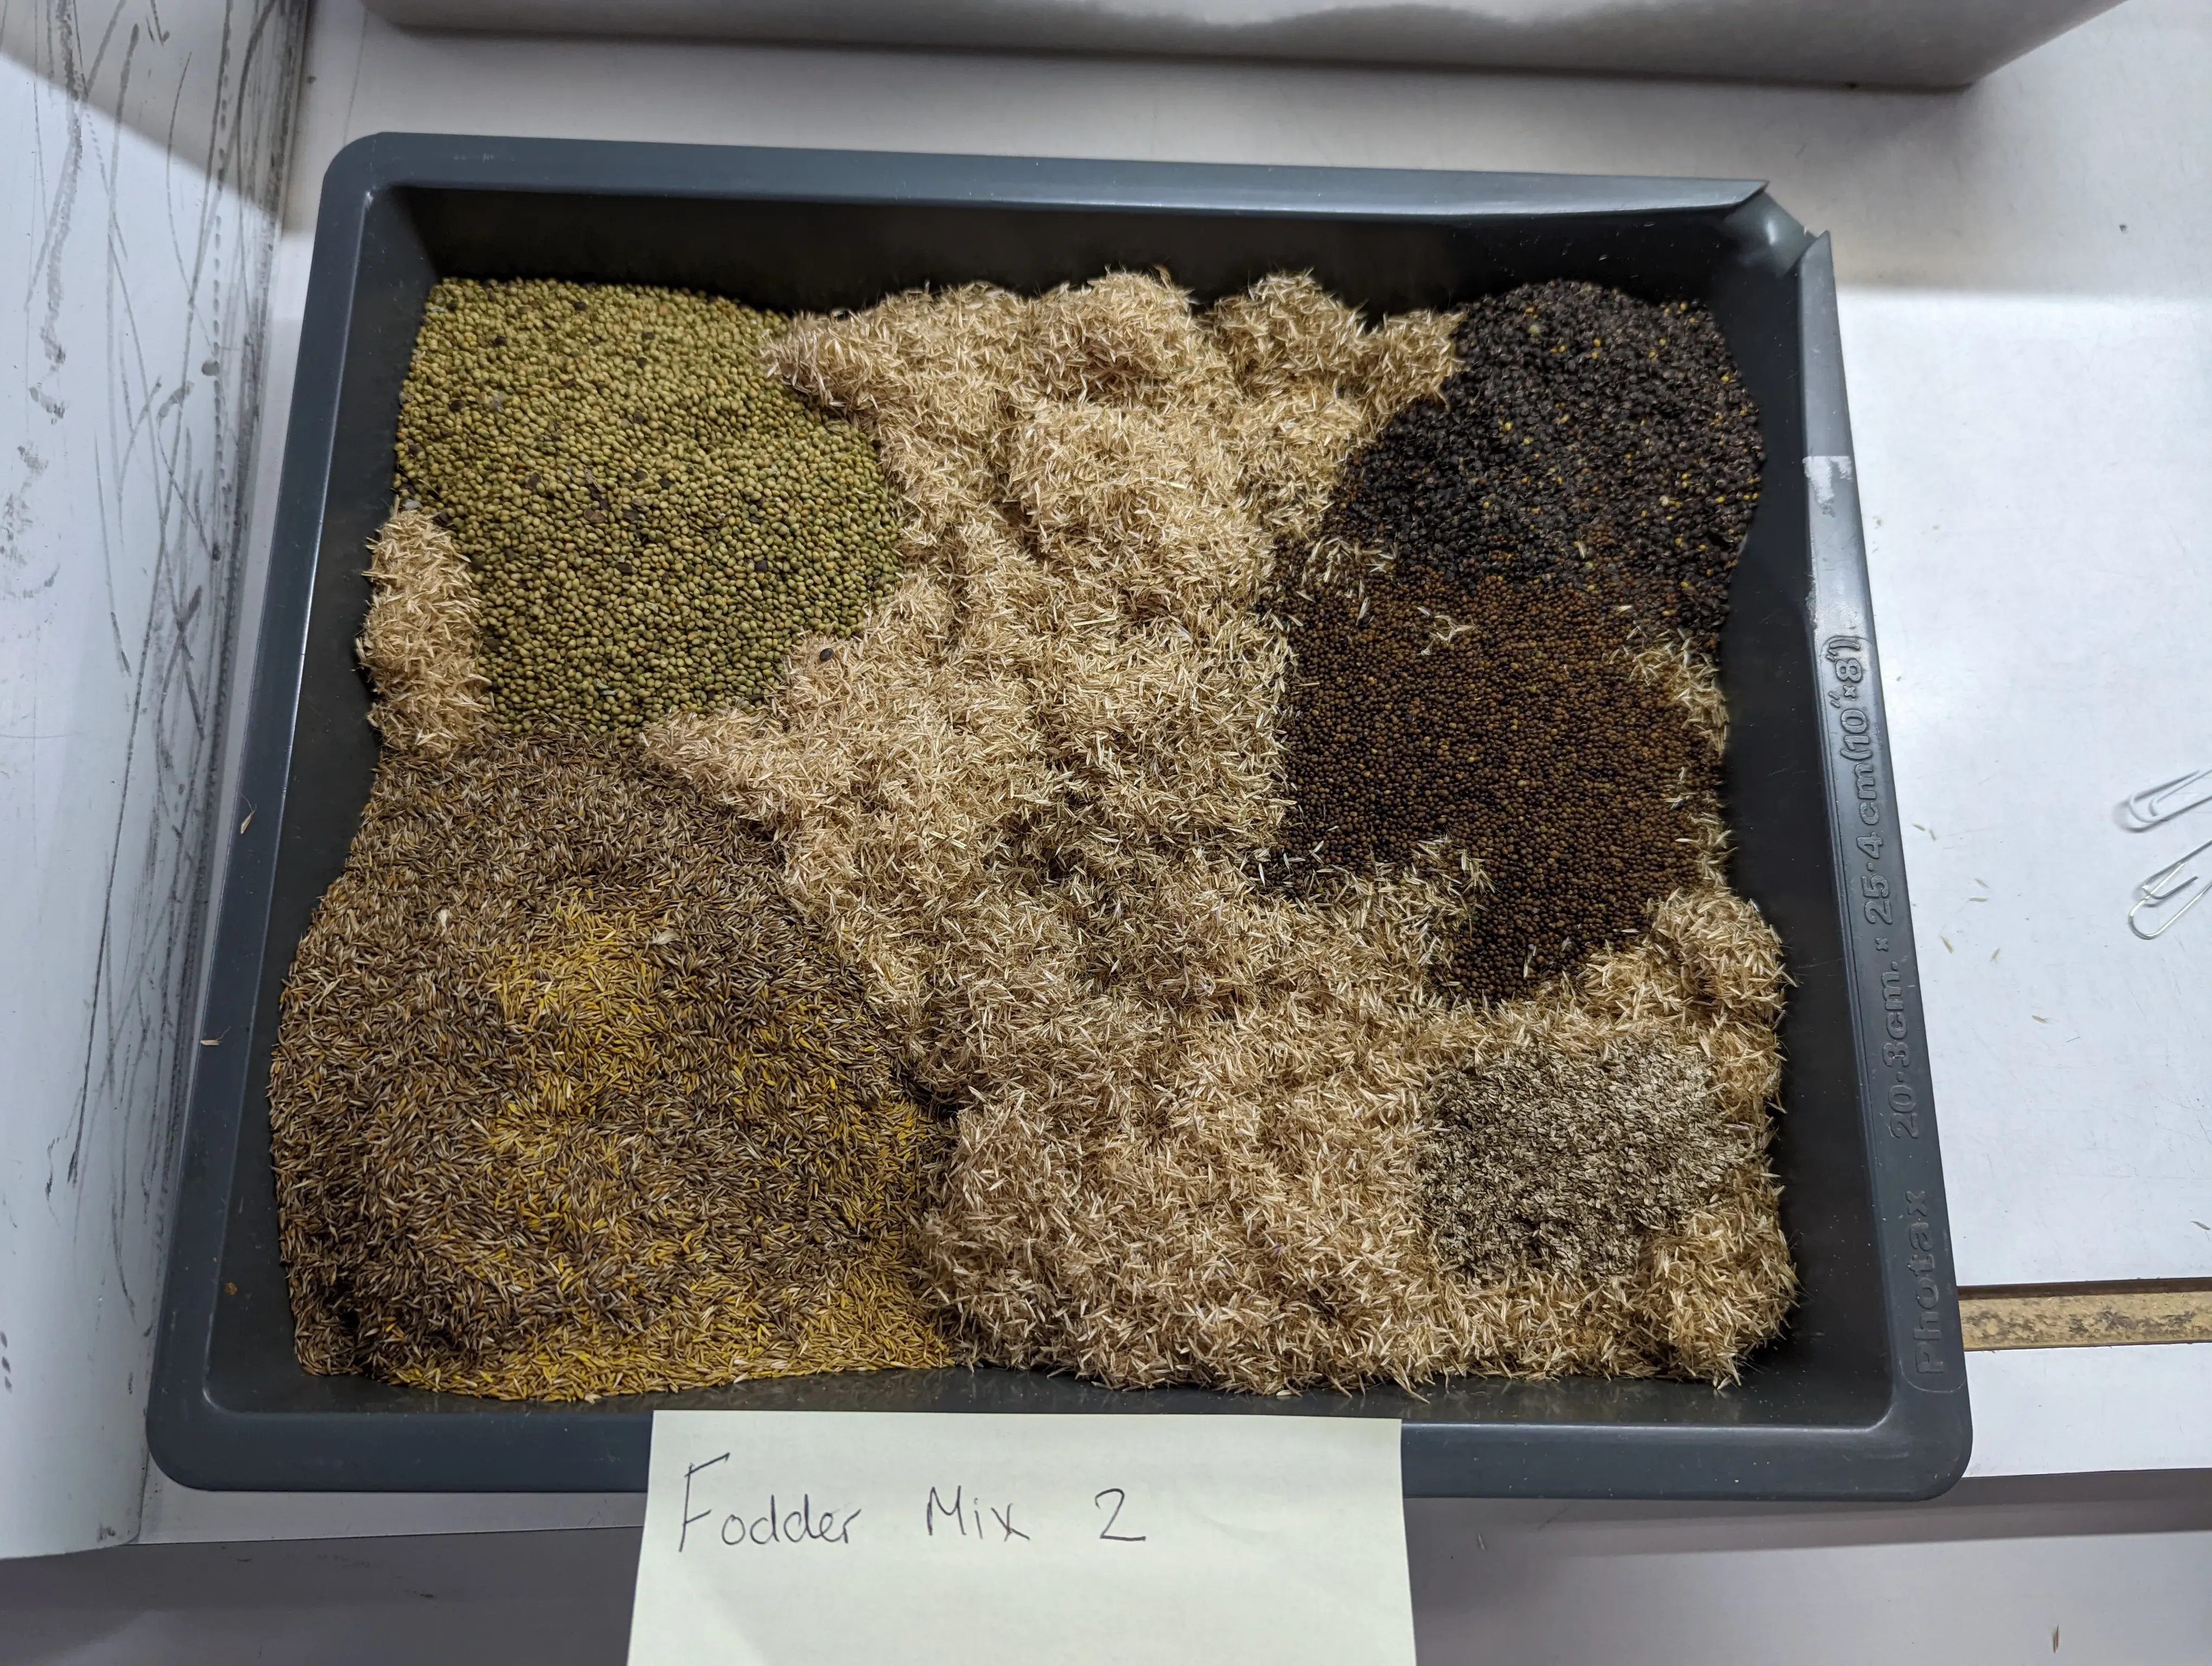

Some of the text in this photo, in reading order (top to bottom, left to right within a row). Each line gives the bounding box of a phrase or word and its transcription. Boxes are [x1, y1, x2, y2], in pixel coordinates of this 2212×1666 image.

[1905, 1190, 1944, 1374] Photax
[678, 1451, 1146, 1554] Fodder Mix 2
